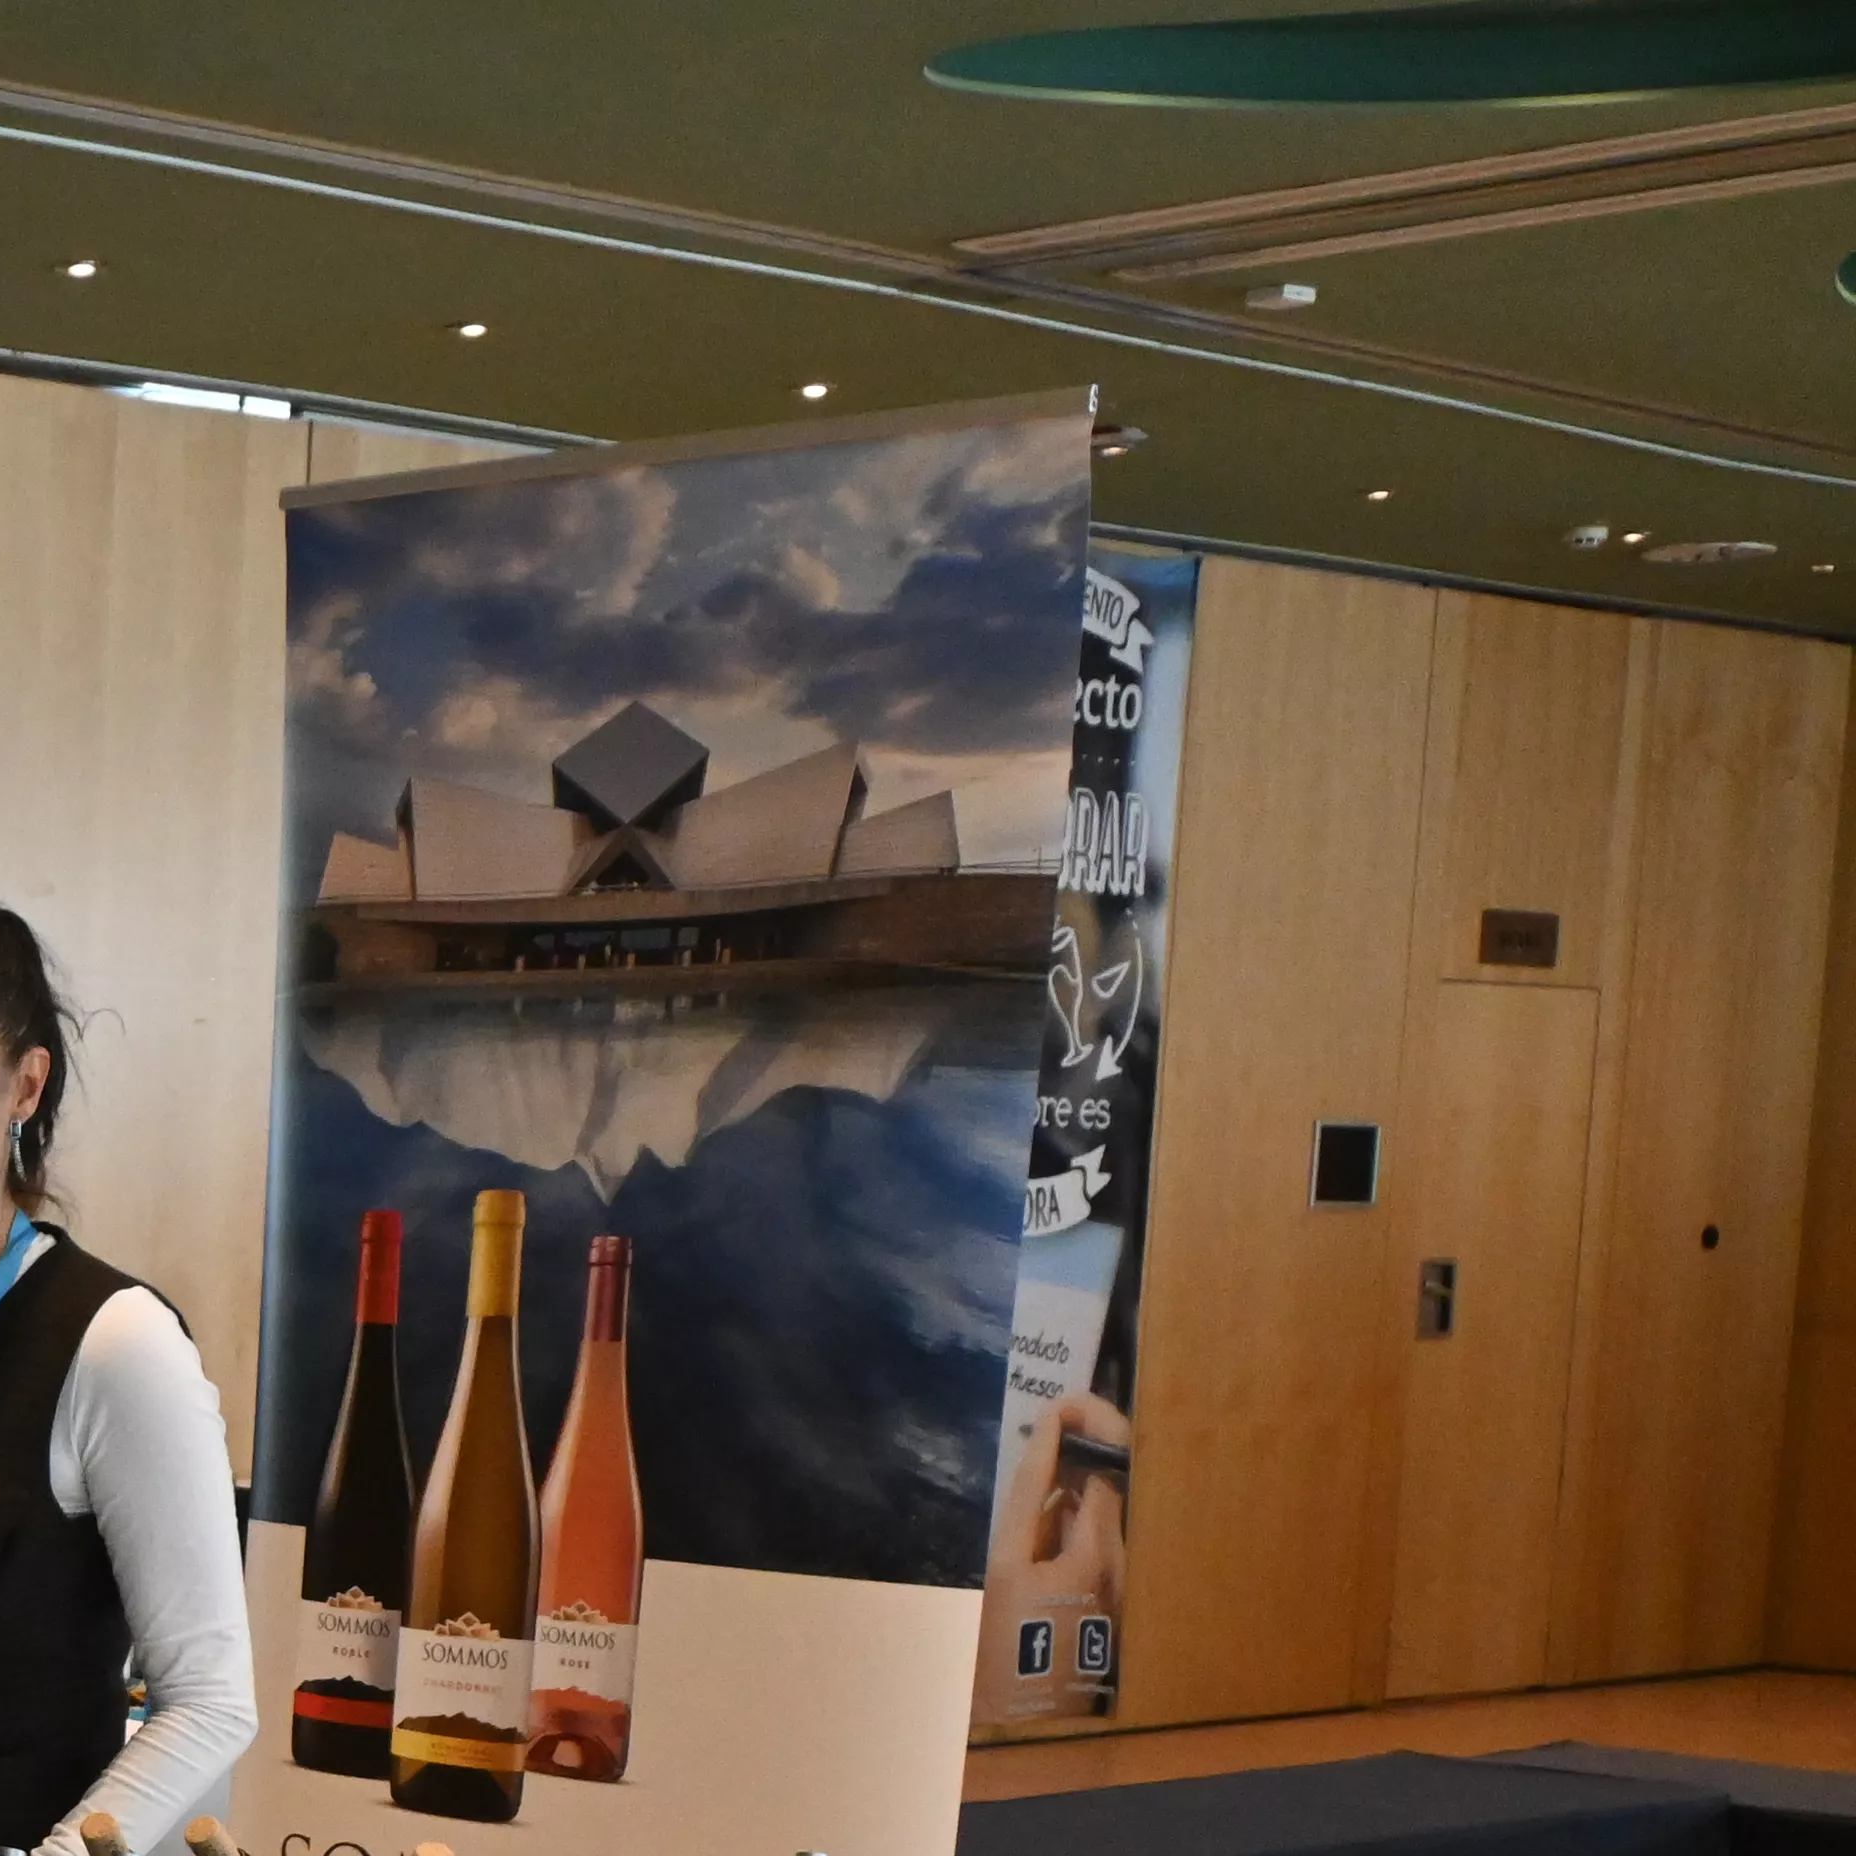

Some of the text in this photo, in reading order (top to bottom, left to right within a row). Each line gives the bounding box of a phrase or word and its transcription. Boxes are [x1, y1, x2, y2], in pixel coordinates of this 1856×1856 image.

[1079, 1097, 1112, 1132] es
[317, 1612, 391, 1638] SOMMOS
[540, 1625, 616, 1651] SOMMOS
[332, 1645, 371, 1660] ROBLE
[422, 1641, 509, 1671] SOMMOS
